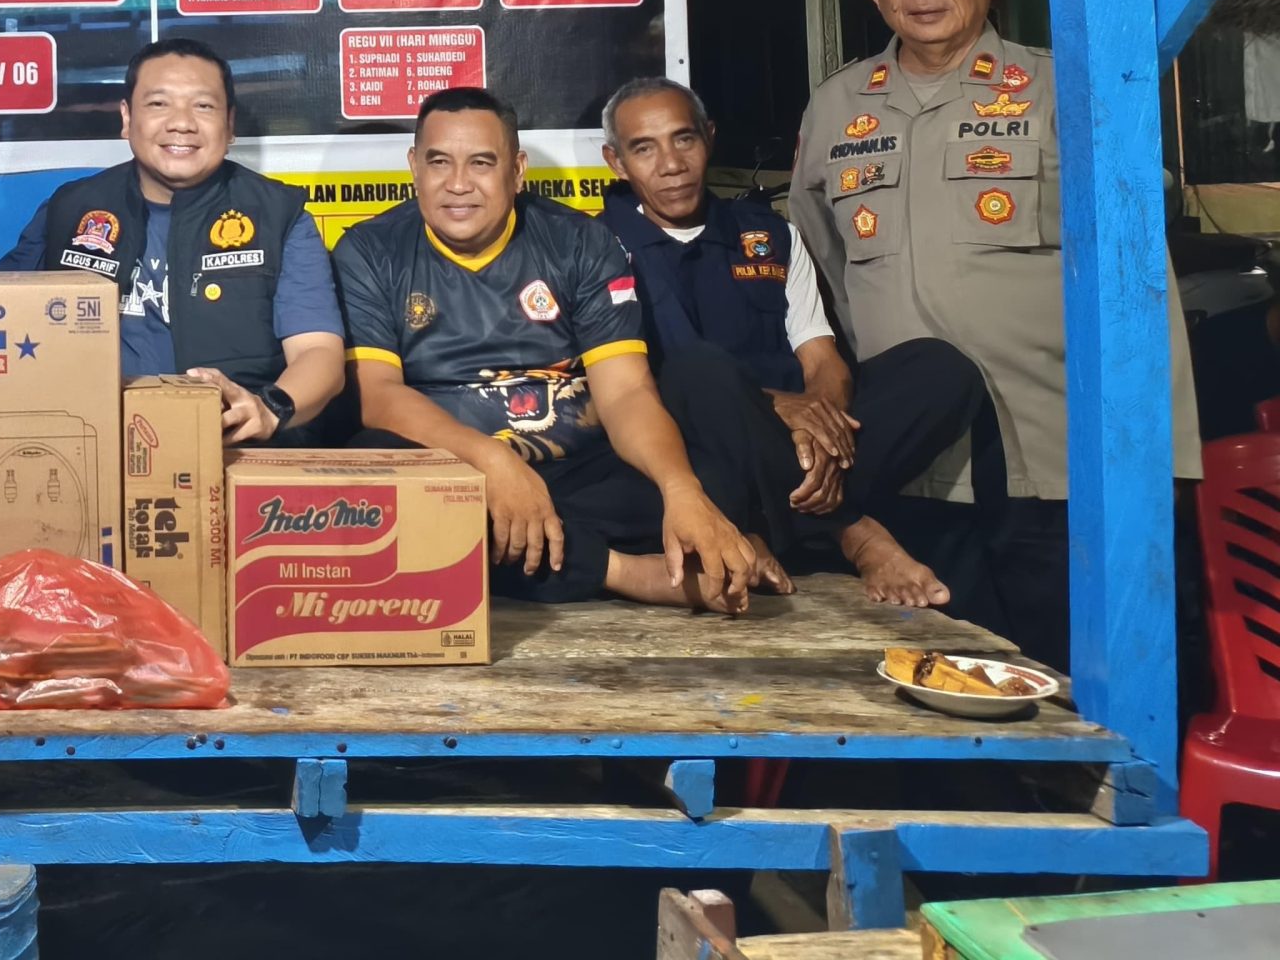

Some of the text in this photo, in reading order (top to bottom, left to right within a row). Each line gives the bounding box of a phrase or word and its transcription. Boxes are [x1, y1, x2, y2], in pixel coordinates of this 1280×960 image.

[349, 34, 475, 47] REGU VII (HARI MINGGU)
[349, 53, 400, 64] 1. SUPRIADI
[406, 53, 414, 62] 5.
[13, 63, 39, 85] 06
[349, 68, 398, 78] 2. RATIMAN
[417, 66, 452, 76] BUDENG
[350, 81, 383, 91] 3. KAIDI
[361, 95, 380, 105] BENI
[959, 121, 1029, 138] POLRI
[66, 254, 116, 273] AGUS ARIF
[206, 254, 260, 267] KAPOLRES
[77, 300, 101, 318] SNI
[135, 498, 153, 558] kotak
[154, 497, 190, 558] teh
[209, 486, 221, 568] 24 x 300 ML
[279, 563, 351, 578] Mi Instan
[276, 592, 443, 625] Mi goreng
